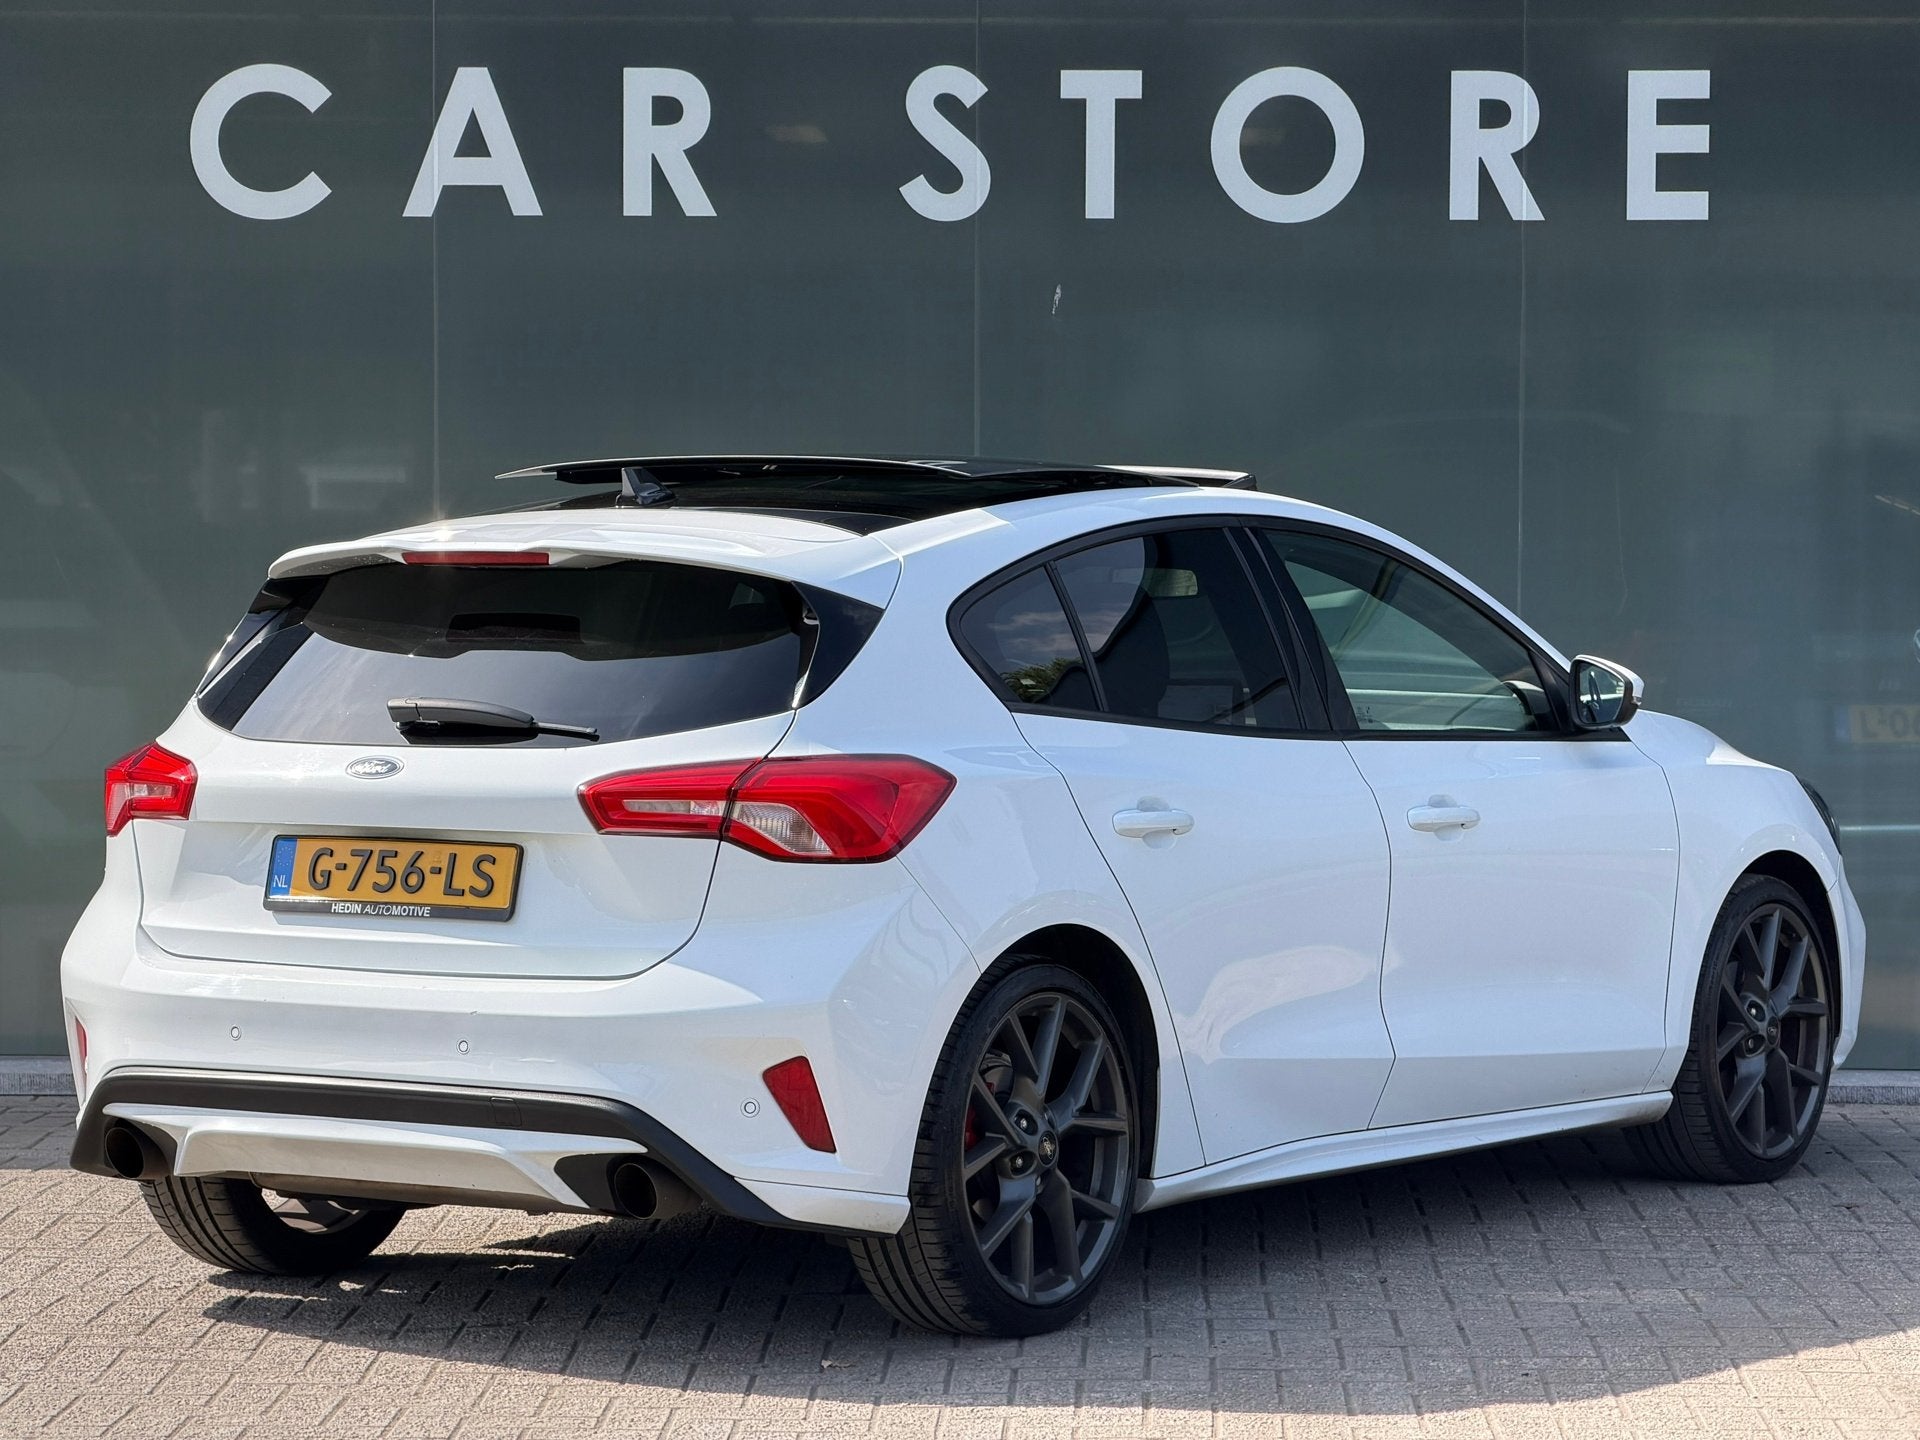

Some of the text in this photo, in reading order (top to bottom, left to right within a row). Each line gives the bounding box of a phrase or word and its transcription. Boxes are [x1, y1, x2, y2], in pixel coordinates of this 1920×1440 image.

[190, 64, 1710, 224] CAR STORE
[273, 875, 288, 888] NL
[308, 847, 496, 898] G-756-LS
[331, 902, 431, 917] HEDIN AUTOMOTIVE
